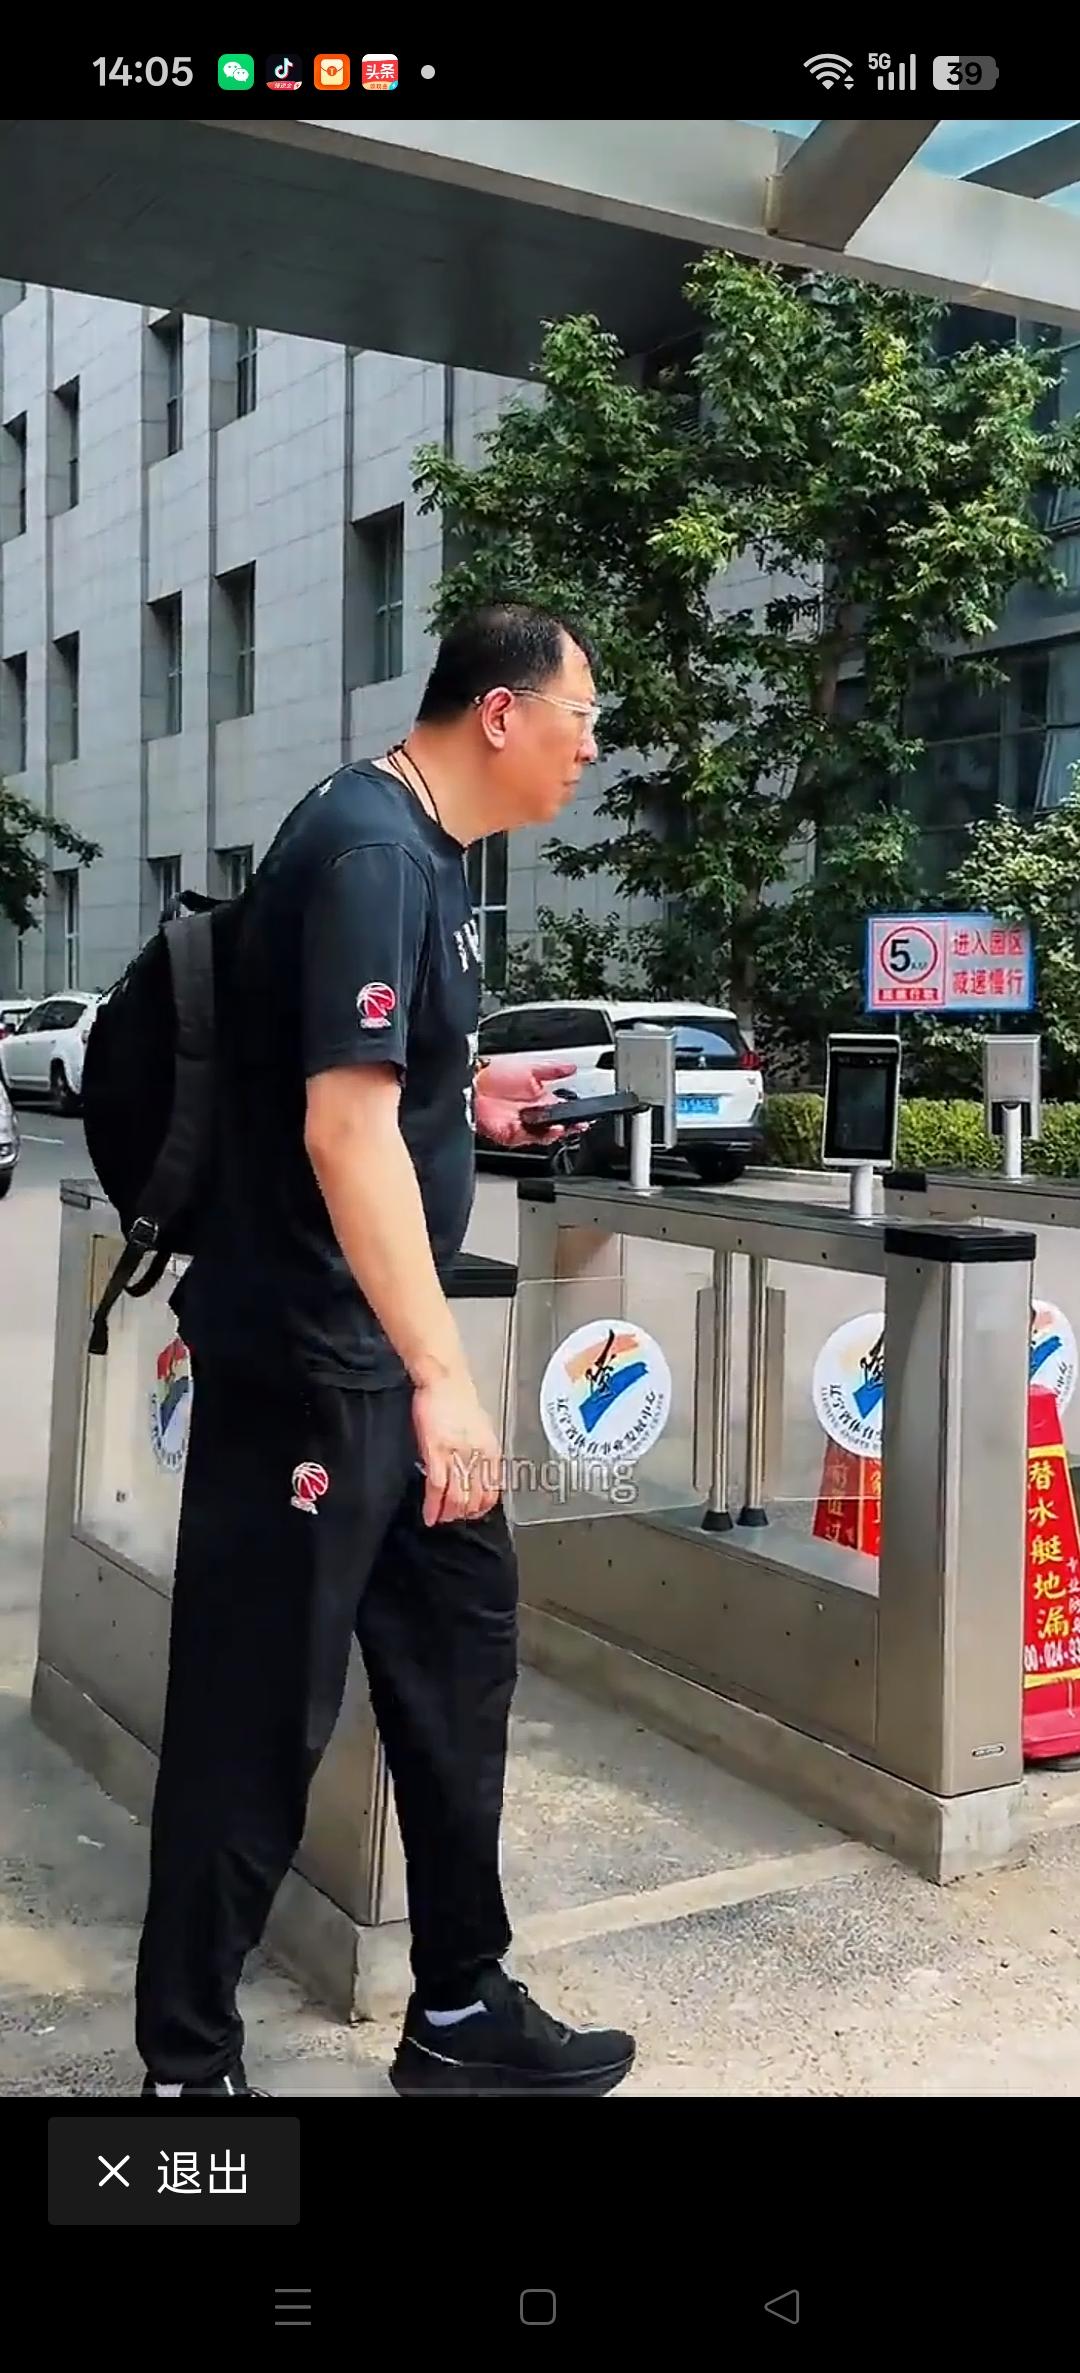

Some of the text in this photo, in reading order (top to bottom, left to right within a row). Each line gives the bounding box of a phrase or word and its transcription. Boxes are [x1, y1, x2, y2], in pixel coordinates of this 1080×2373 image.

[889, 939, 911, 972] 5
[953, 928, 1024, 956] 进入园区
[953, 968, 1025, 995] 减速慢行
[1028, 1460, 1070, 1639] 潜水艇地漏
